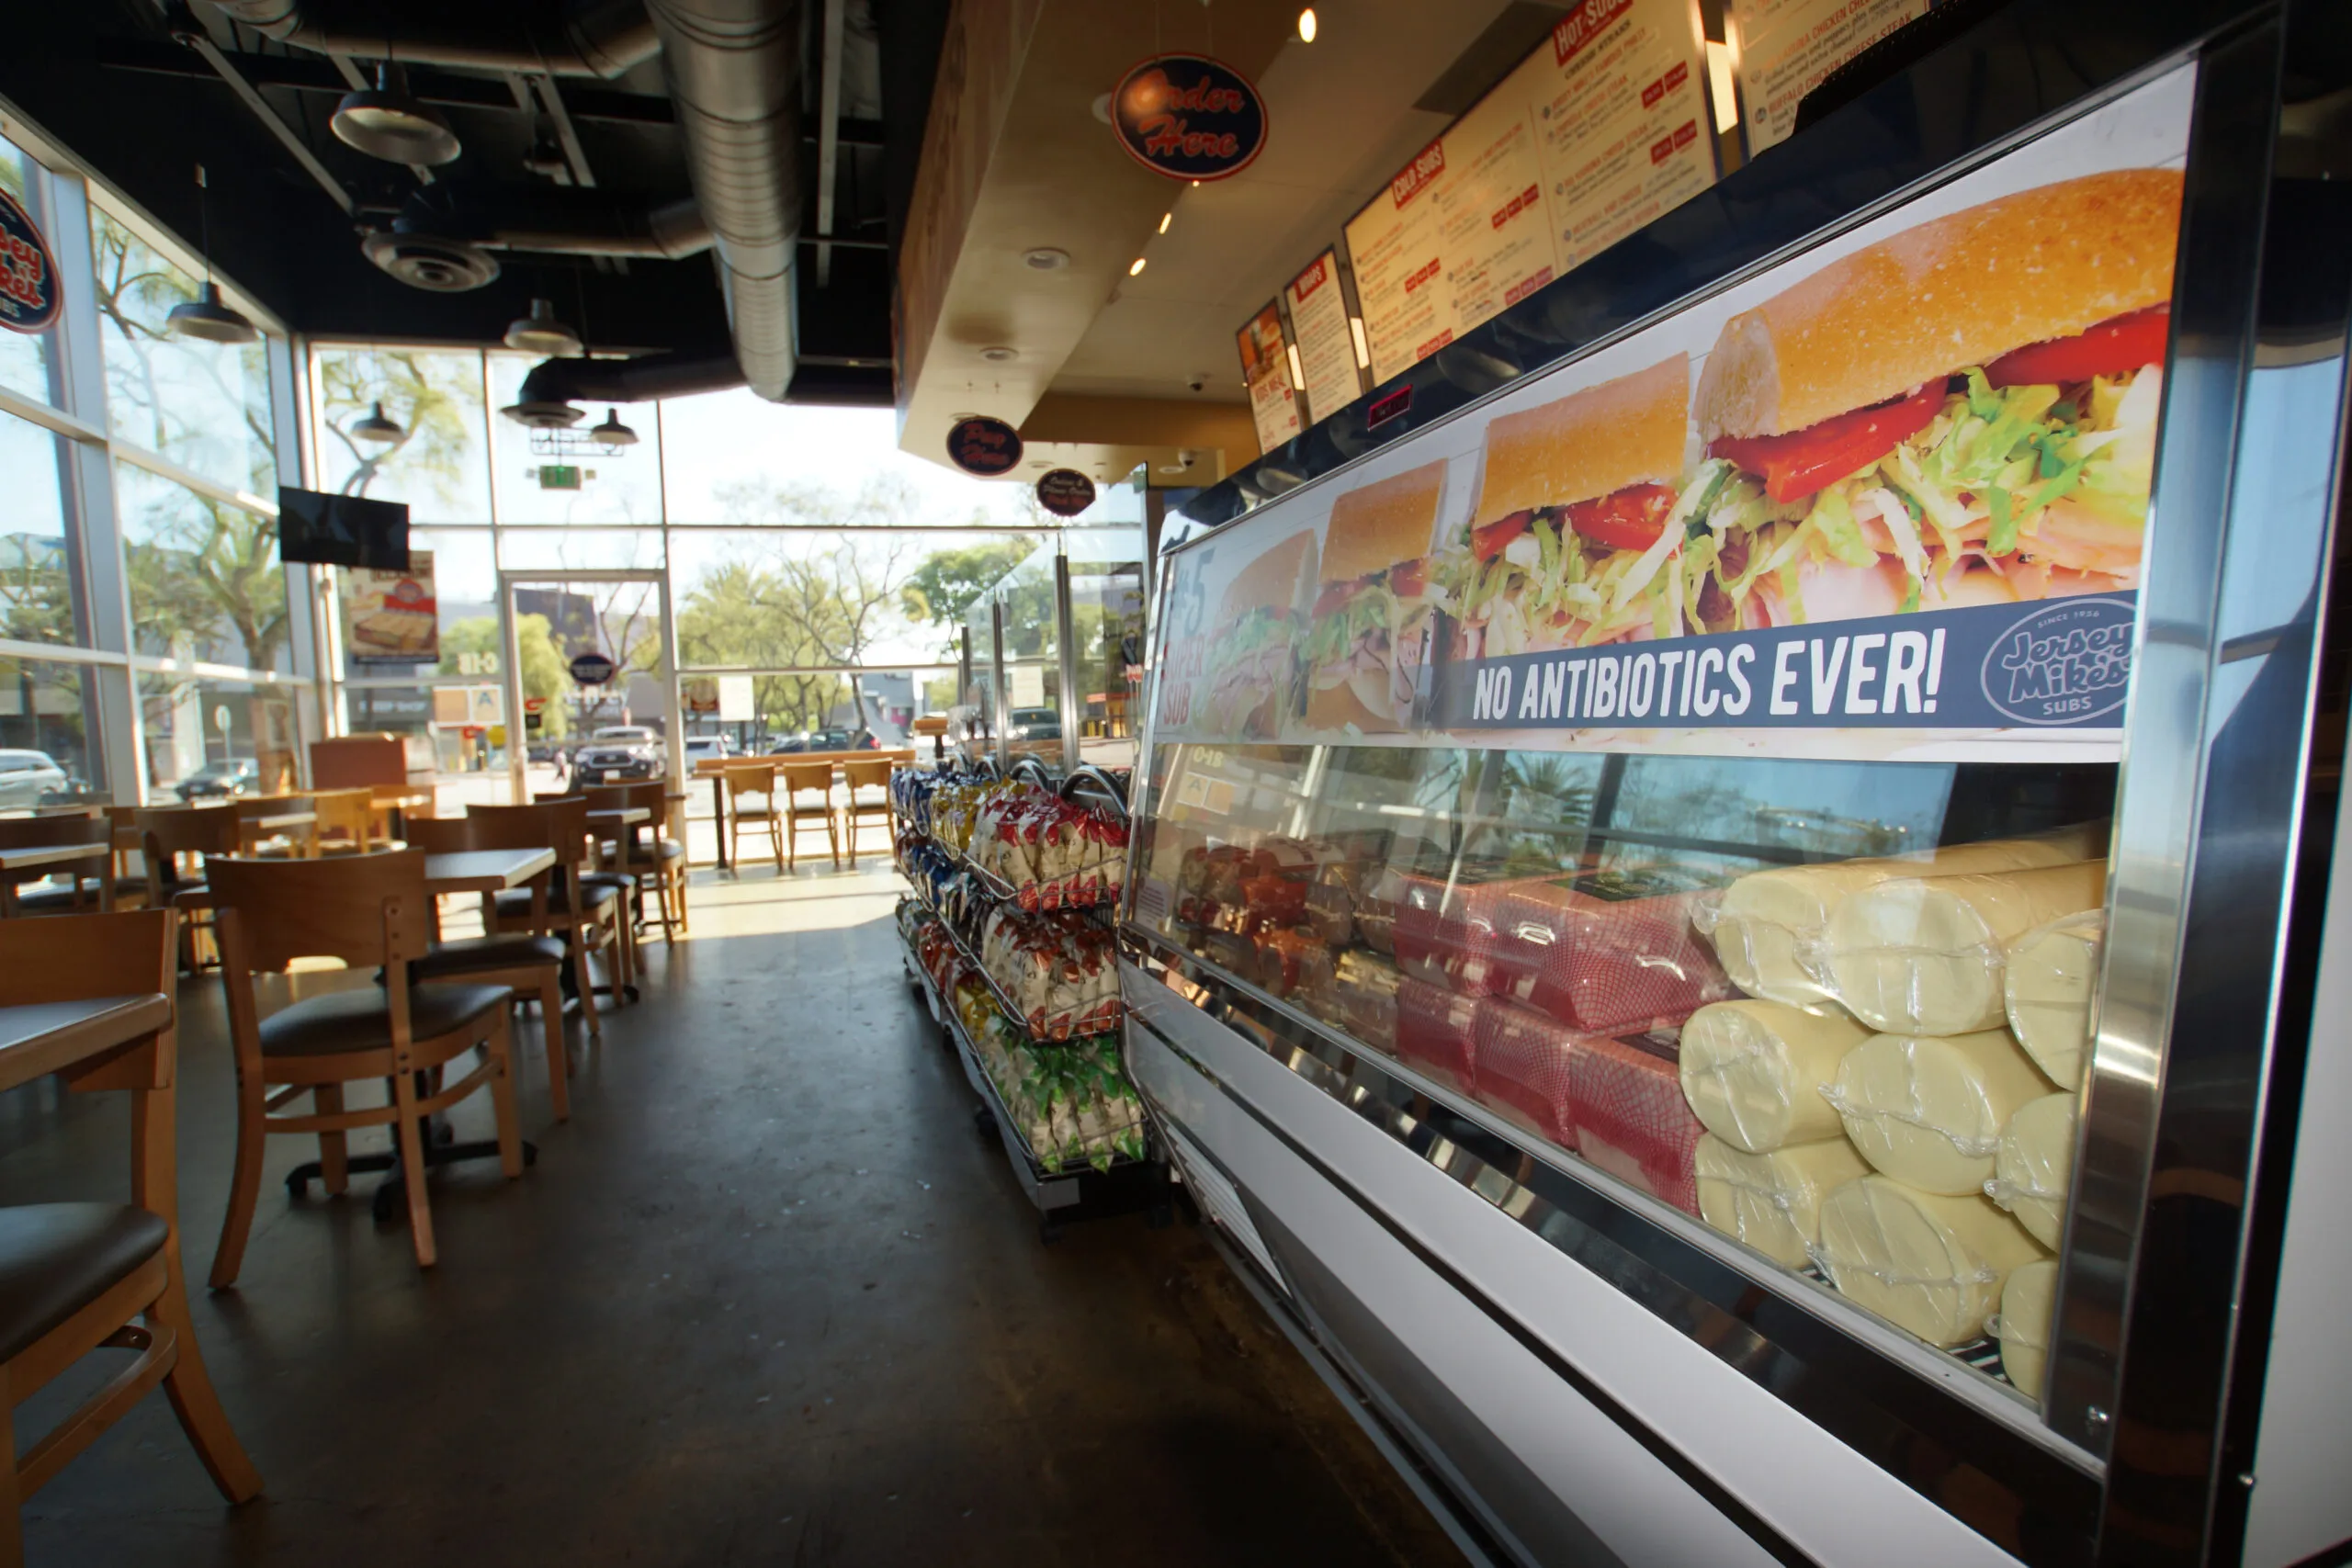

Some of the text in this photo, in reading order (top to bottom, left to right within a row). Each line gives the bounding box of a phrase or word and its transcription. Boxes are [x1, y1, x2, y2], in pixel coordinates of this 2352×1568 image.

[1556, 15, 1582, 57] HOT
[1585, 0, 1625, 27] SU
[1812, 5, 1847, 39] CHICKEN
[1138, 114, 1239, 158] Here
[2038, 613, 2069, 629] SINCE
[1161, 634, 1205, 682] SUPER
[2001, 622, 2135, 671] Jersey
[1473, 627, 1947, 720] NO ANTIBIOTICS EVER!
[1164, 682, 1192, 726] SUB
[2042, 695, 2093, 716] SUBS
